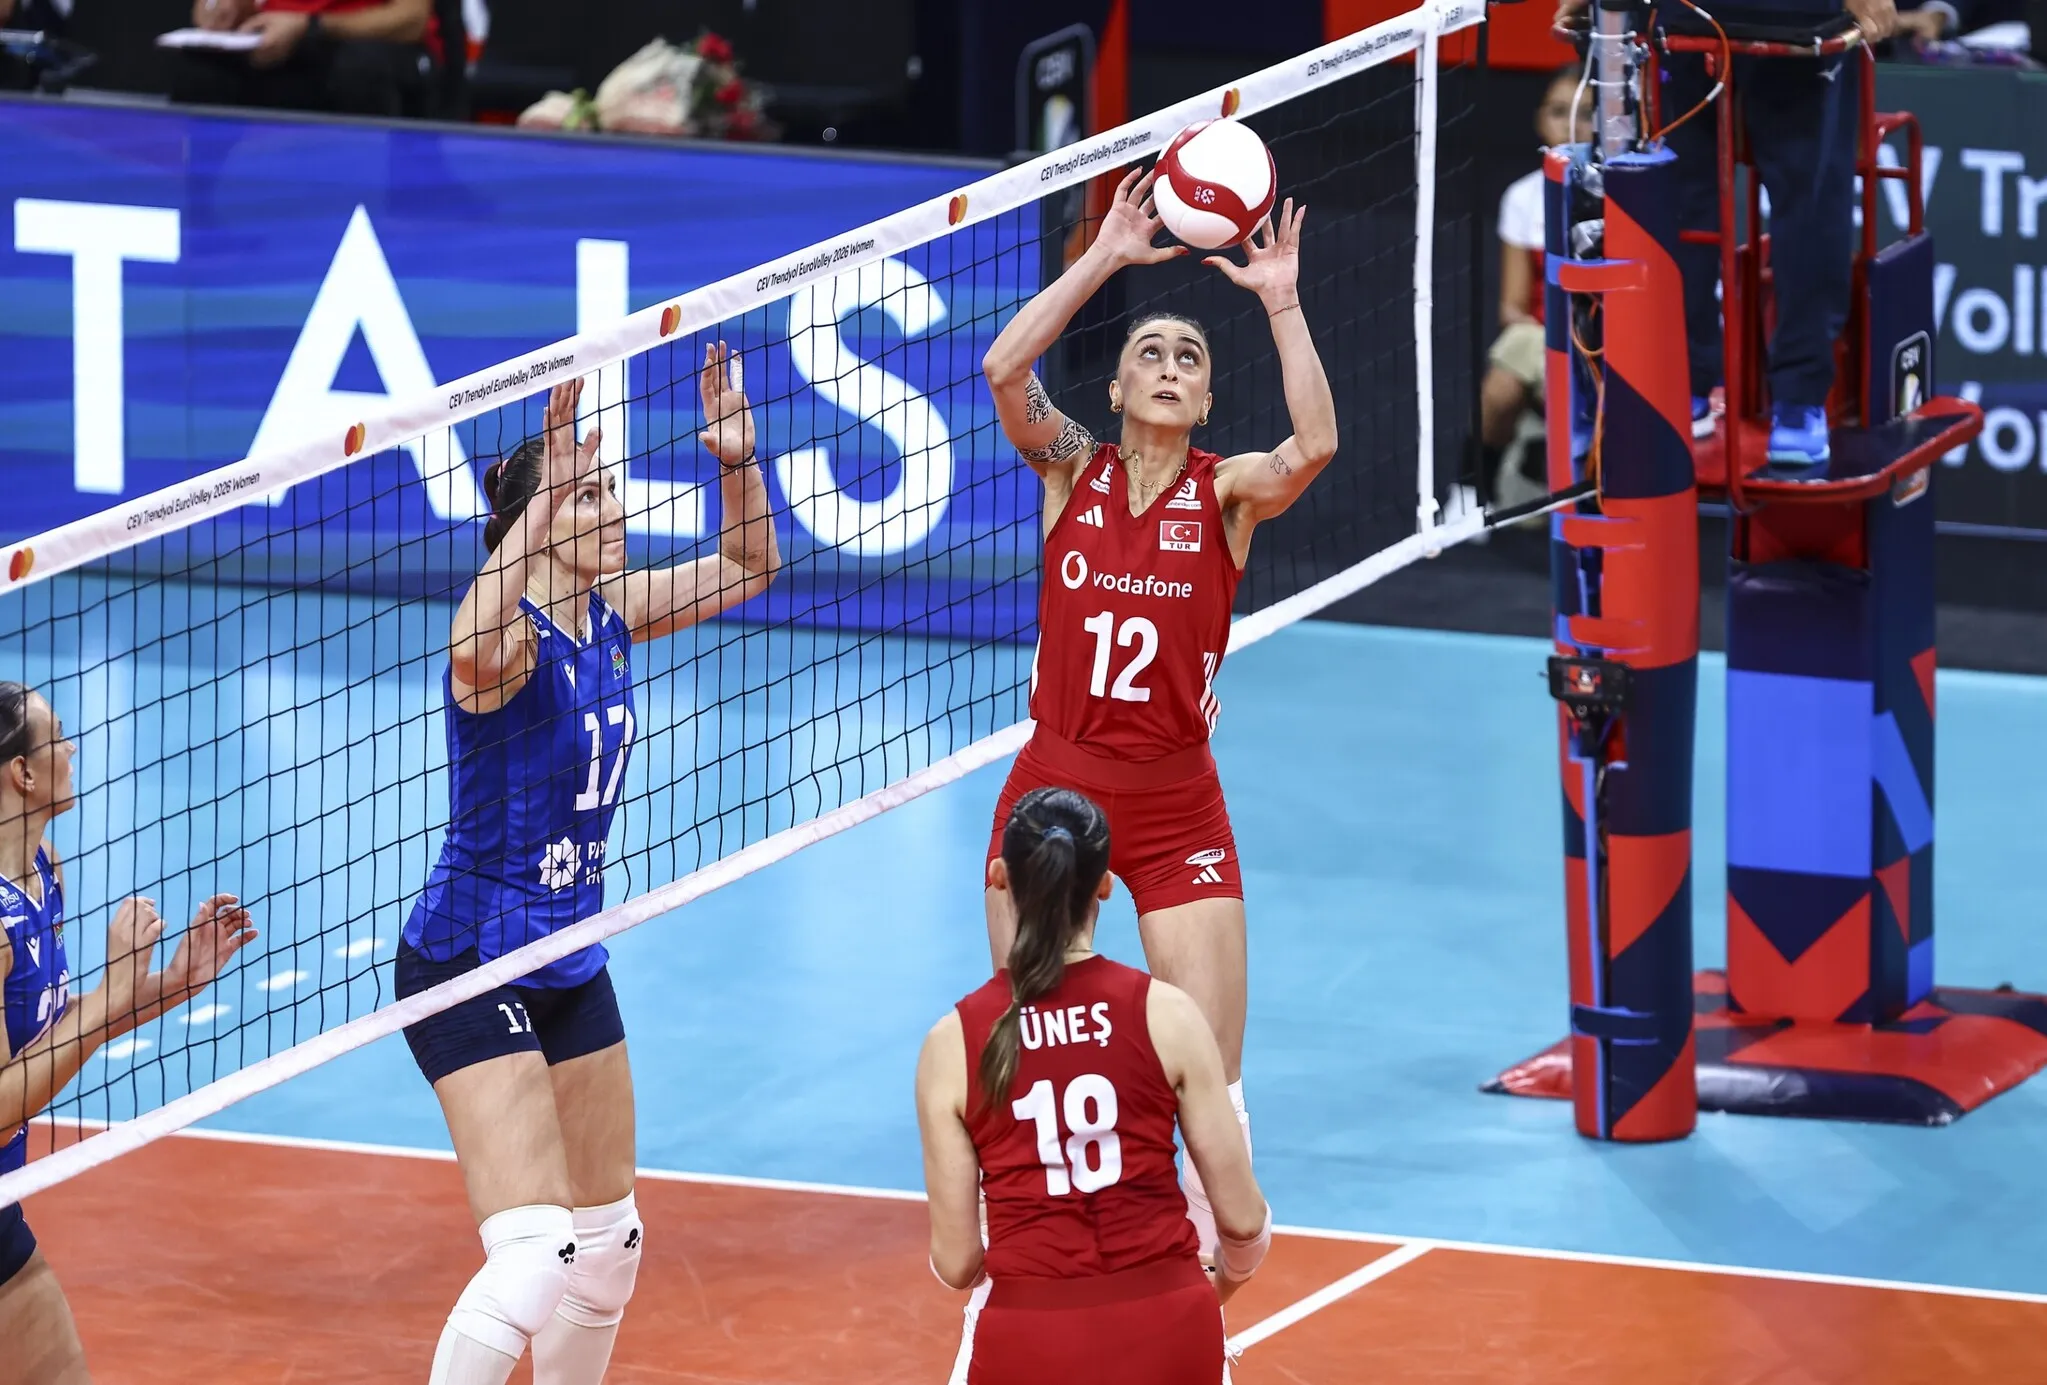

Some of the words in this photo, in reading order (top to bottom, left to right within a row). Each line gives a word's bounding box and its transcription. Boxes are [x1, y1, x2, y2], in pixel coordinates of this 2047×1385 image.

[1041, 165, 1054, 181] CEV
[1055, 154, 1079, 175] Trendyol
[1080, 143, 1112, 166] EuroVolley
[1128, 131, 1151, 147] Women
[757, 276, 771, 292] CEV
[771, 264, 798, 287] Trendyol
[798, 253, 833, 276] EuroVolley
[833, 245, 849, 262] 2026
[850, 239, 874, 255] Women
[449, 389, 465, 409] CEV
[465, 380, 493, 404] Trendyol
[494, 367, 530, 393] EuroVolley
[530, 362, 547, 379] 2026
[548, 354, 574, 372] Women
[127, 512, 143, 530] CEV
[144, 500, 175, 524] Trendyol
[175, 489, 212, 513] EuroVolley
[213, 480, 232, 499] 2026
[233, 472, 260, 490] Women
[1169, 542, 1191, 550] TUR
[1093, 571, 1193, 598] vodafone
[1084, 610, 1159, 702] 12
[573, 703, 634, 811] 17
[1019, 1001, 1113, 1050] ÜNEŞ
[1011, 1073, 1122, 1196] 18
